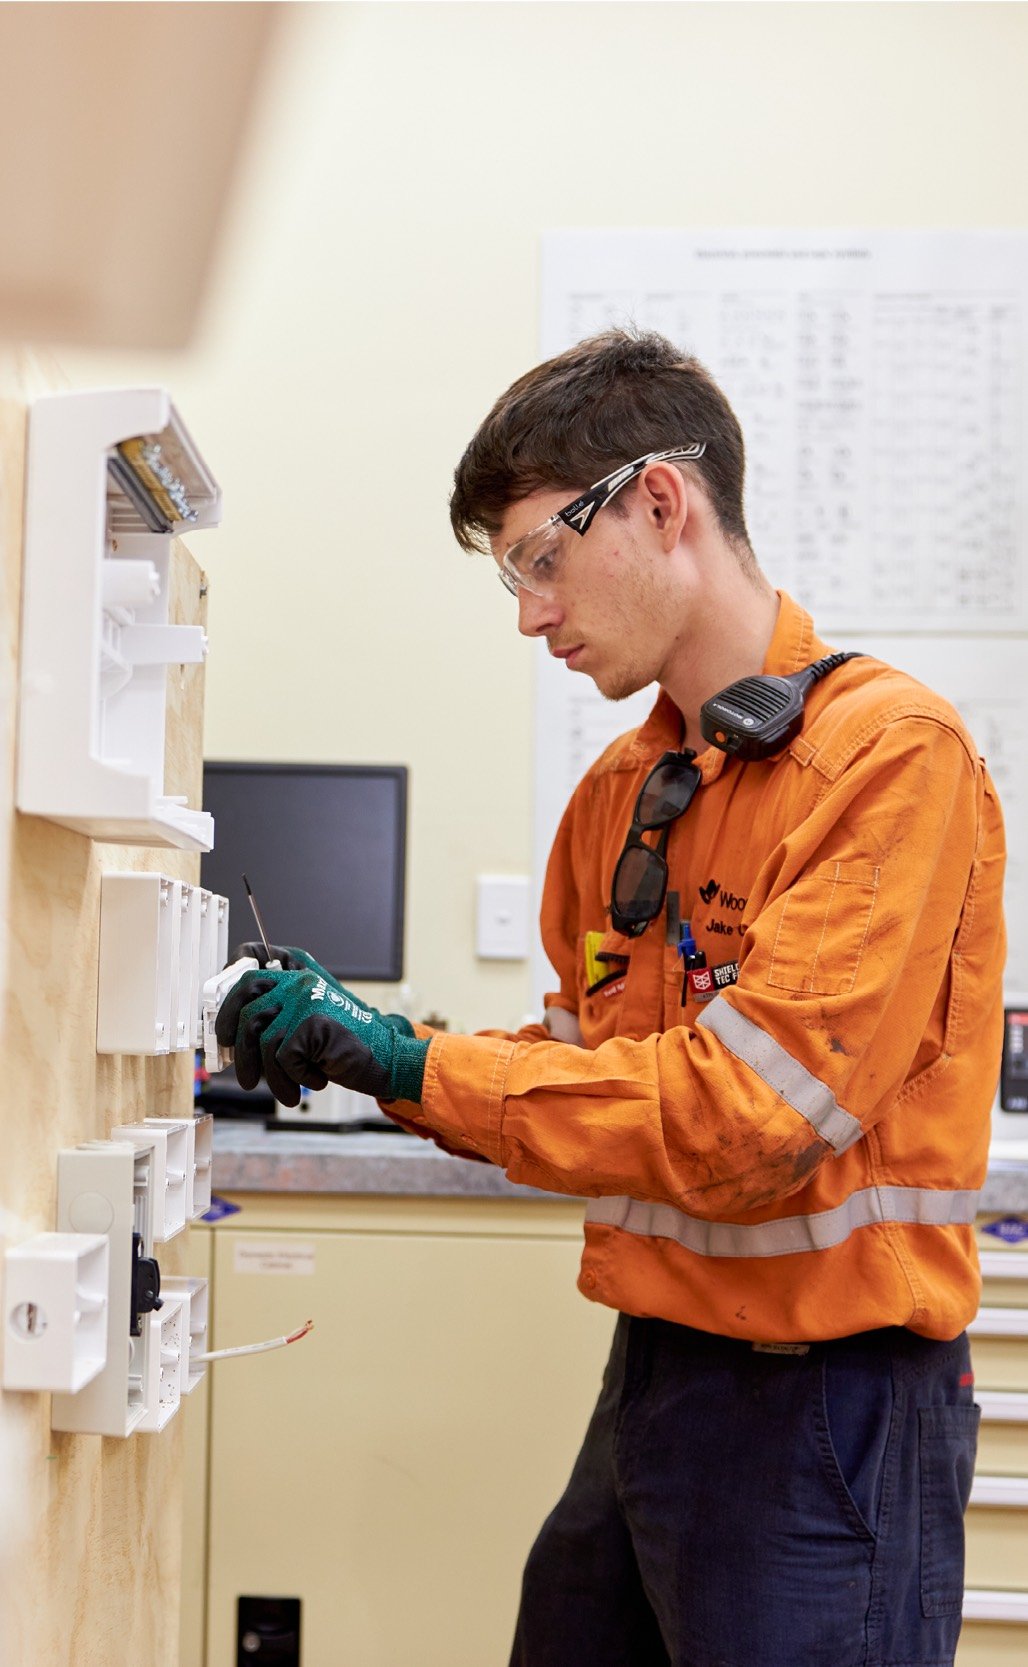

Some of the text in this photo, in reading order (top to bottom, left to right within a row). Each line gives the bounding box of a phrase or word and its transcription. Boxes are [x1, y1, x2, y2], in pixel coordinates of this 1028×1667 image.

[720, 890, 748, 911] Woo
[706, 919, 733, 936] Jake
[716, 974, 731, 985] TEC
